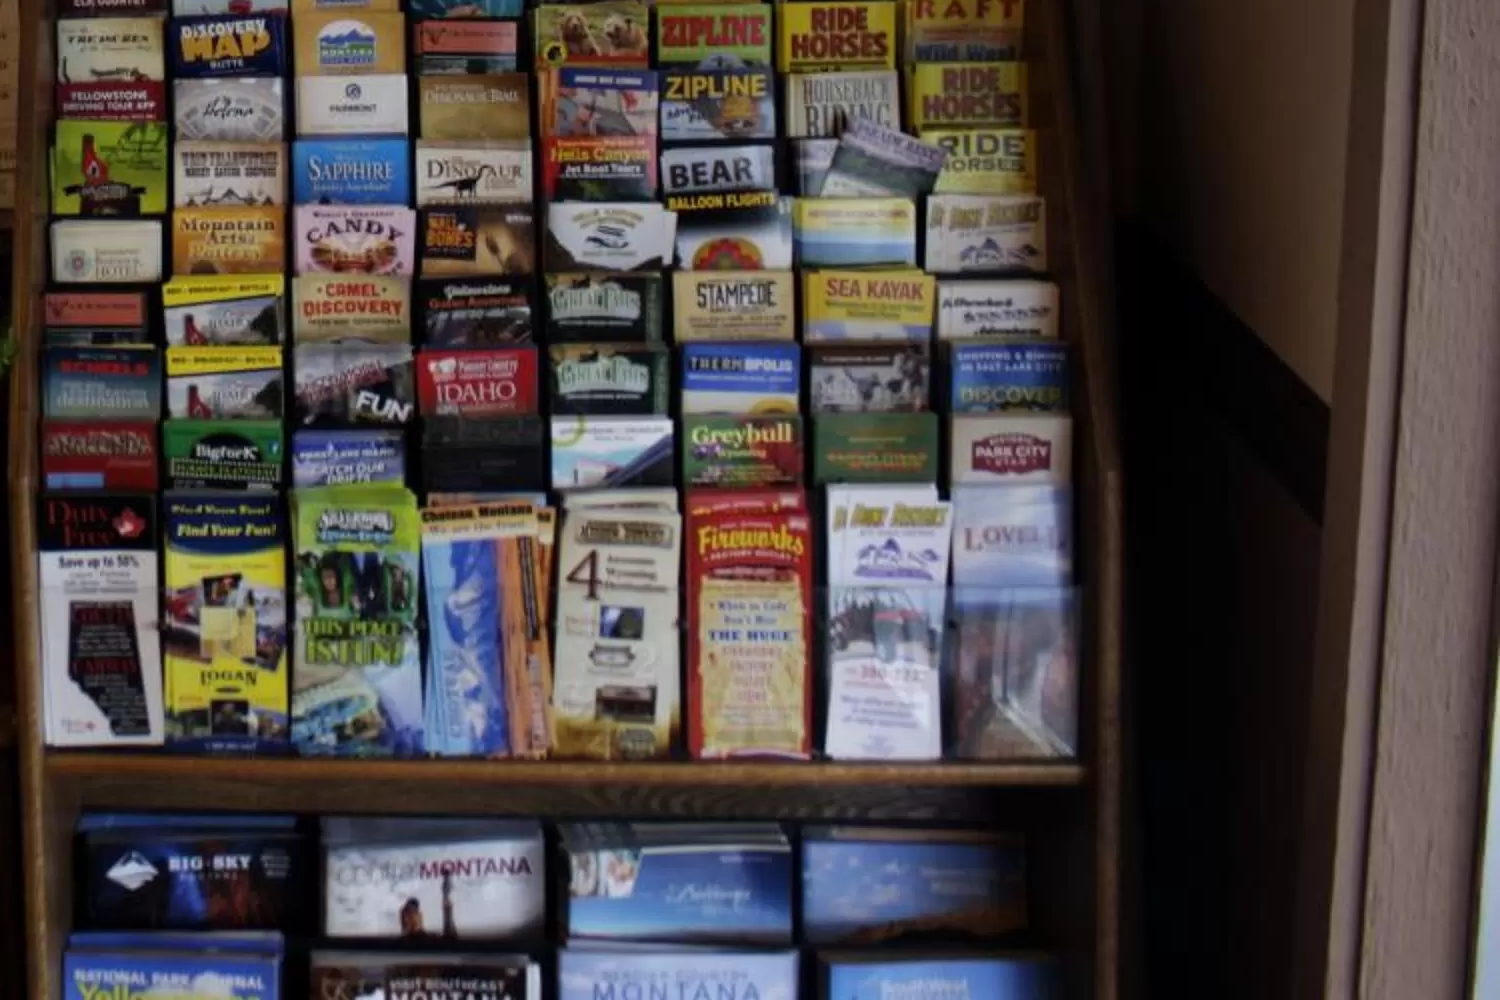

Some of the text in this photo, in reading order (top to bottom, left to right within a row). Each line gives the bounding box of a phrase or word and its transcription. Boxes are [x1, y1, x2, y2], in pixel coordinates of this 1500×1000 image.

[180, 19, 266, 37] DISCOVERY
[661, 15, 766, 47] ZIPLINE
[811, 6, 869, 32] RIDE
[181, 29, 270, 62] MAP
[790, 32, 889, 58] HORSES
[665, 74, 767, 99] ZIPLINE
[803, 77, 890, 101] HORSEBACK
[942, 67, 1002, 93] RIDE
[69, 89, 148, 101] YELLOWSTONE
[922, 93, 1021, 120] HORSES
[937, 133, 1026, 157] RIDE
[308, 154, 395, 181] SAPPHIRE
[668, 156, 753, 190] BEAR
[667, 192, 775, 211] BALLOON FLIGHTS
[180, 217, 276, 232] Mountain
[306, 218, 404, 245] CANDY
[325, 283, 380, 297] CAMEL
[696, 280, 778, 308] STAMPEDE
[827, 278, 925, 300] SEA KAYAK
[303, 300, 403, 317] DISCOVERY
[691, 355, 793, 373] THERMOPOLIS
[436, 382, 517, 402] IDAHO
[960, 386, 1062, 403] DISCOVER
[354, 390, 414, 423] FUN
[691, 421, 794, 448] Greybull
[974, 445, 1048, 458] PARK CITY
[176, 523, 277, 537] Find Your Fun!
[697, 524, 805, 556] Fireworks
[87, 557, 101, 570] up
[566, 549, 603, 601] 4
[200, 670, 258, 686] LOGAN
[167, 853, 253, 872] BIG SKY
[419, 855, 533, 880] MONTANA
[73, 968, 191, 985] NATIONAL PARK
[591, 981, 762, 1000] MONTANA
